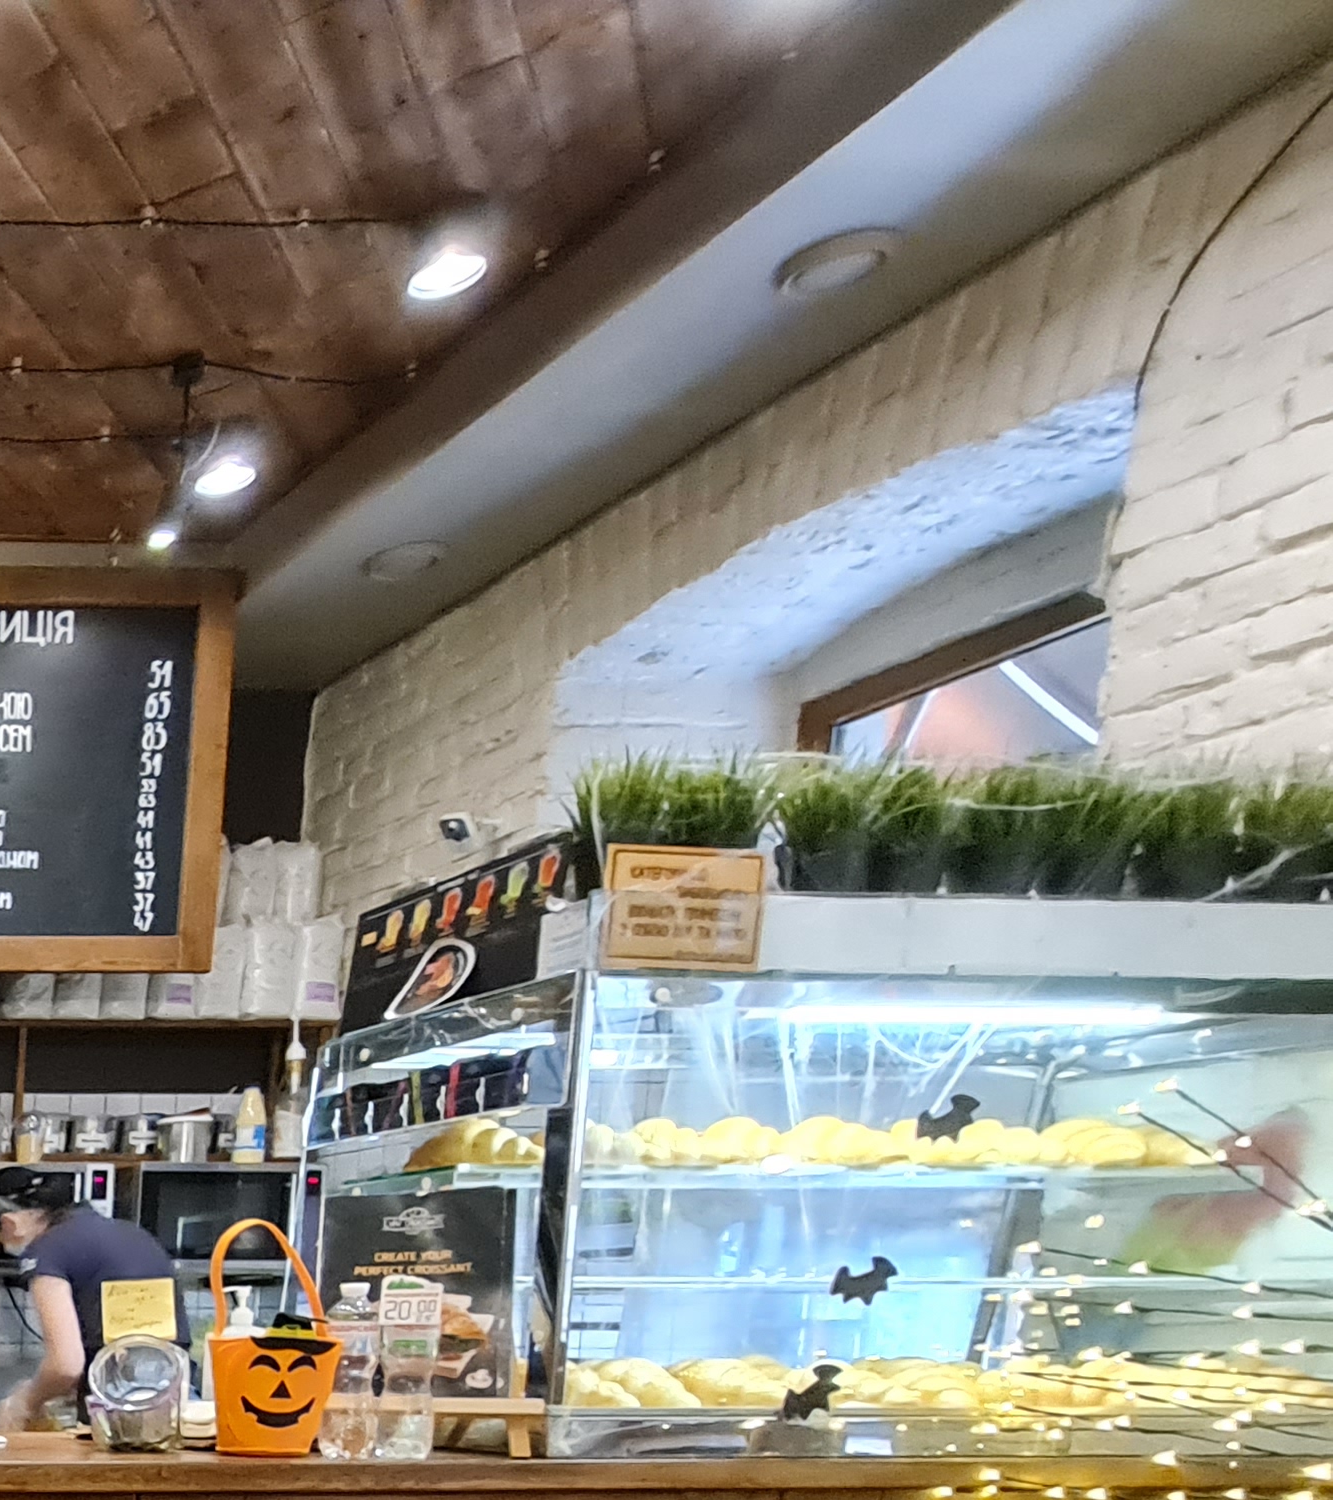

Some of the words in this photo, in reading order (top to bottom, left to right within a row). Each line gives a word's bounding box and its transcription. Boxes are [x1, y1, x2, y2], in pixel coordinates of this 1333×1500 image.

[148, 660, 174, 689] 51
[144, 691, 171, 719] 65
[141, 722, 168, 750] 83
[139, 752, 163, 777] 51
[384, 1300, 412, 1320] 20
